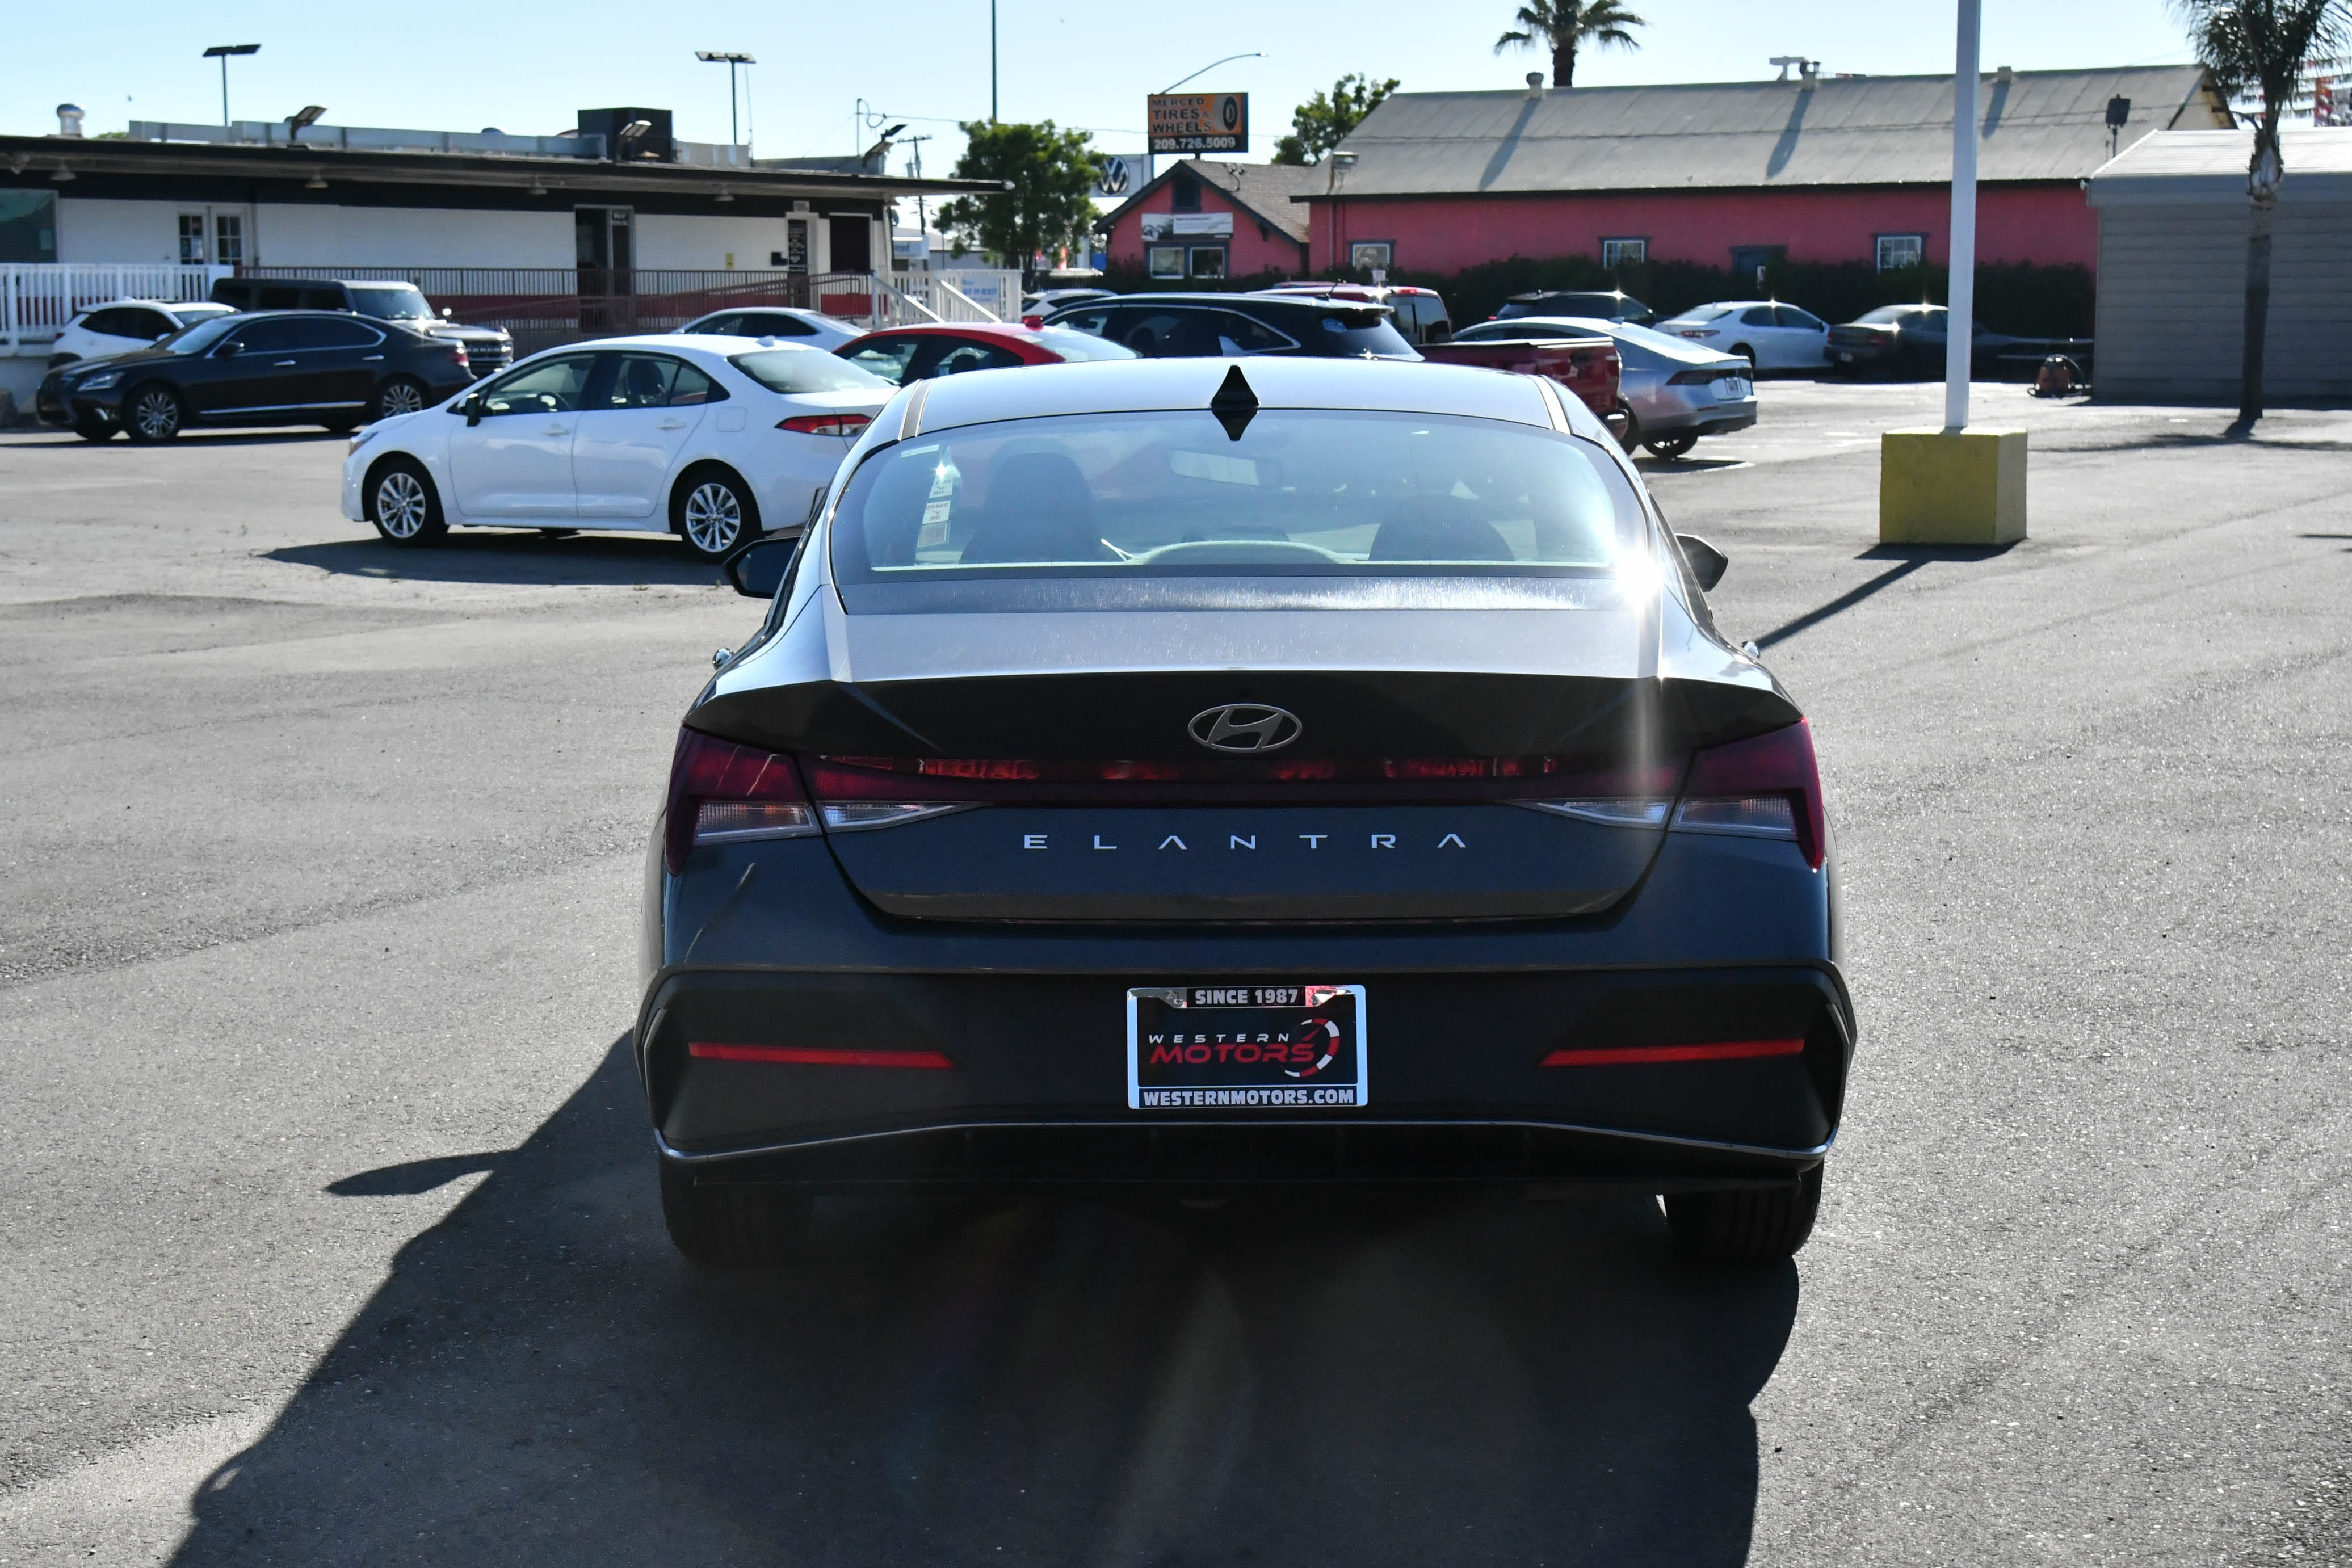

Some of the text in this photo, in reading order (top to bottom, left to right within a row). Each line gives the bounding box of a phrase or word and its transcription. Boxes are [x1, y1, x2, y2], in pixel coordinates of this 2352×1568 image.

[1152, 98, 1204, 107] MERCED
[1153, 109, 1199, 120] TIRES
[1153, 121, 1212, 133] WHEELS
[1154, 137, 1236, 150] 209.726.5009
[1024, 834, 1467, 850] ELANTRA
[1195, 989, 1298, 1004] SINCE 1987
[1149, 1033, 1290, 1044] WESTERN
[1149, 1043, 1315, 1064] MOTORS
[1144, 1089, 1354, 1106] WESTERNMOTORS.COM
